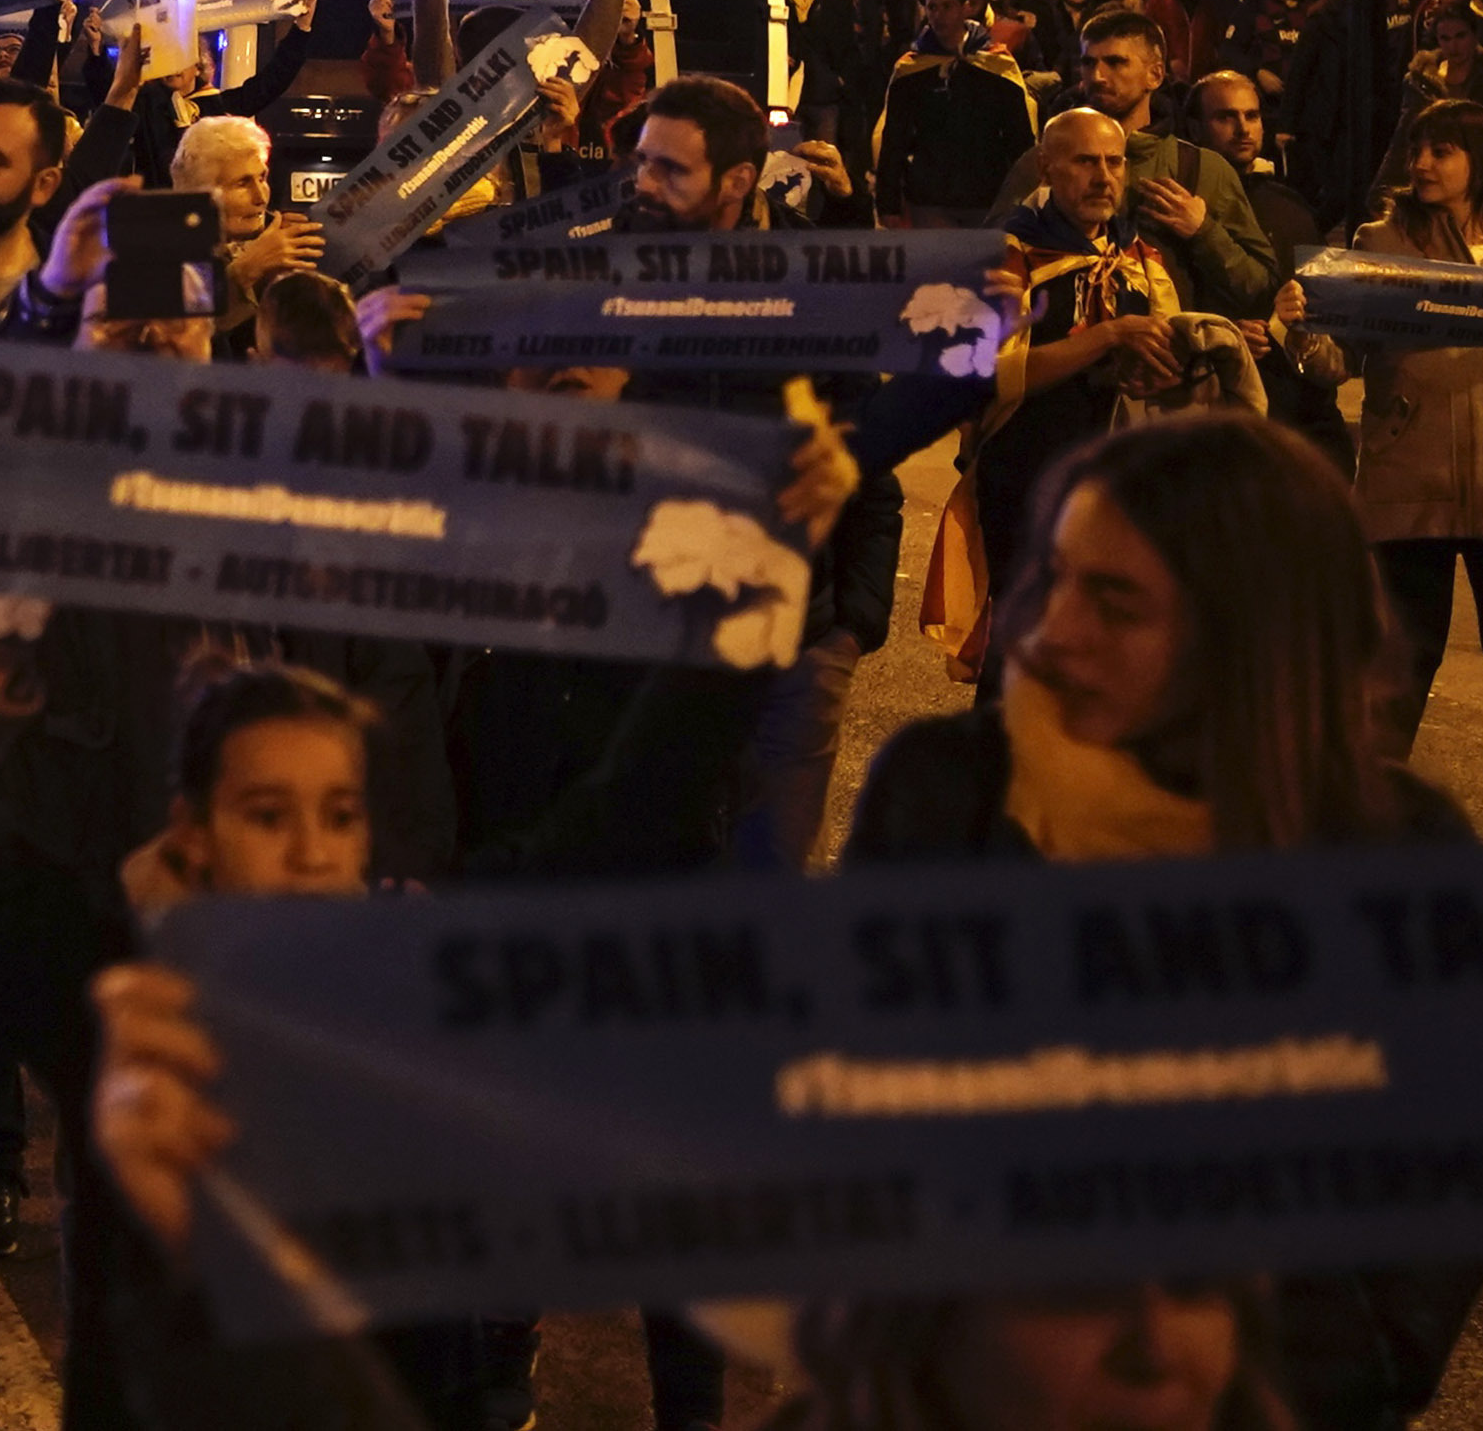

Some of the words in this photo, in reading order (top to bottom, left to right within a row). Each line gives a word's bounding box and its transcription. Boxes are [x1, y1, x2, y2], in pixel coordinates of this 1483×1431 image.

[387, 134, 423, 168] SIT
[418, 98, 463, 142] AND
[457, 48, 517, 103] TALK!
[492, 245, 623, 286] SPAIN,
[634, 244, 692, 284] SIT
[707, 244, 789, 284] AND
[801, 245, 907, 284] TALK!
[171, 387, 273, 458] SIT
[293, 397, 433, 472] AND
[461, 413, 632, 494] TALK!
[434, 915, 817, 1036] SPAIN,
[845, 904, 1012, 1018] SIT
[1069, 895, 1315, 1008] AND
